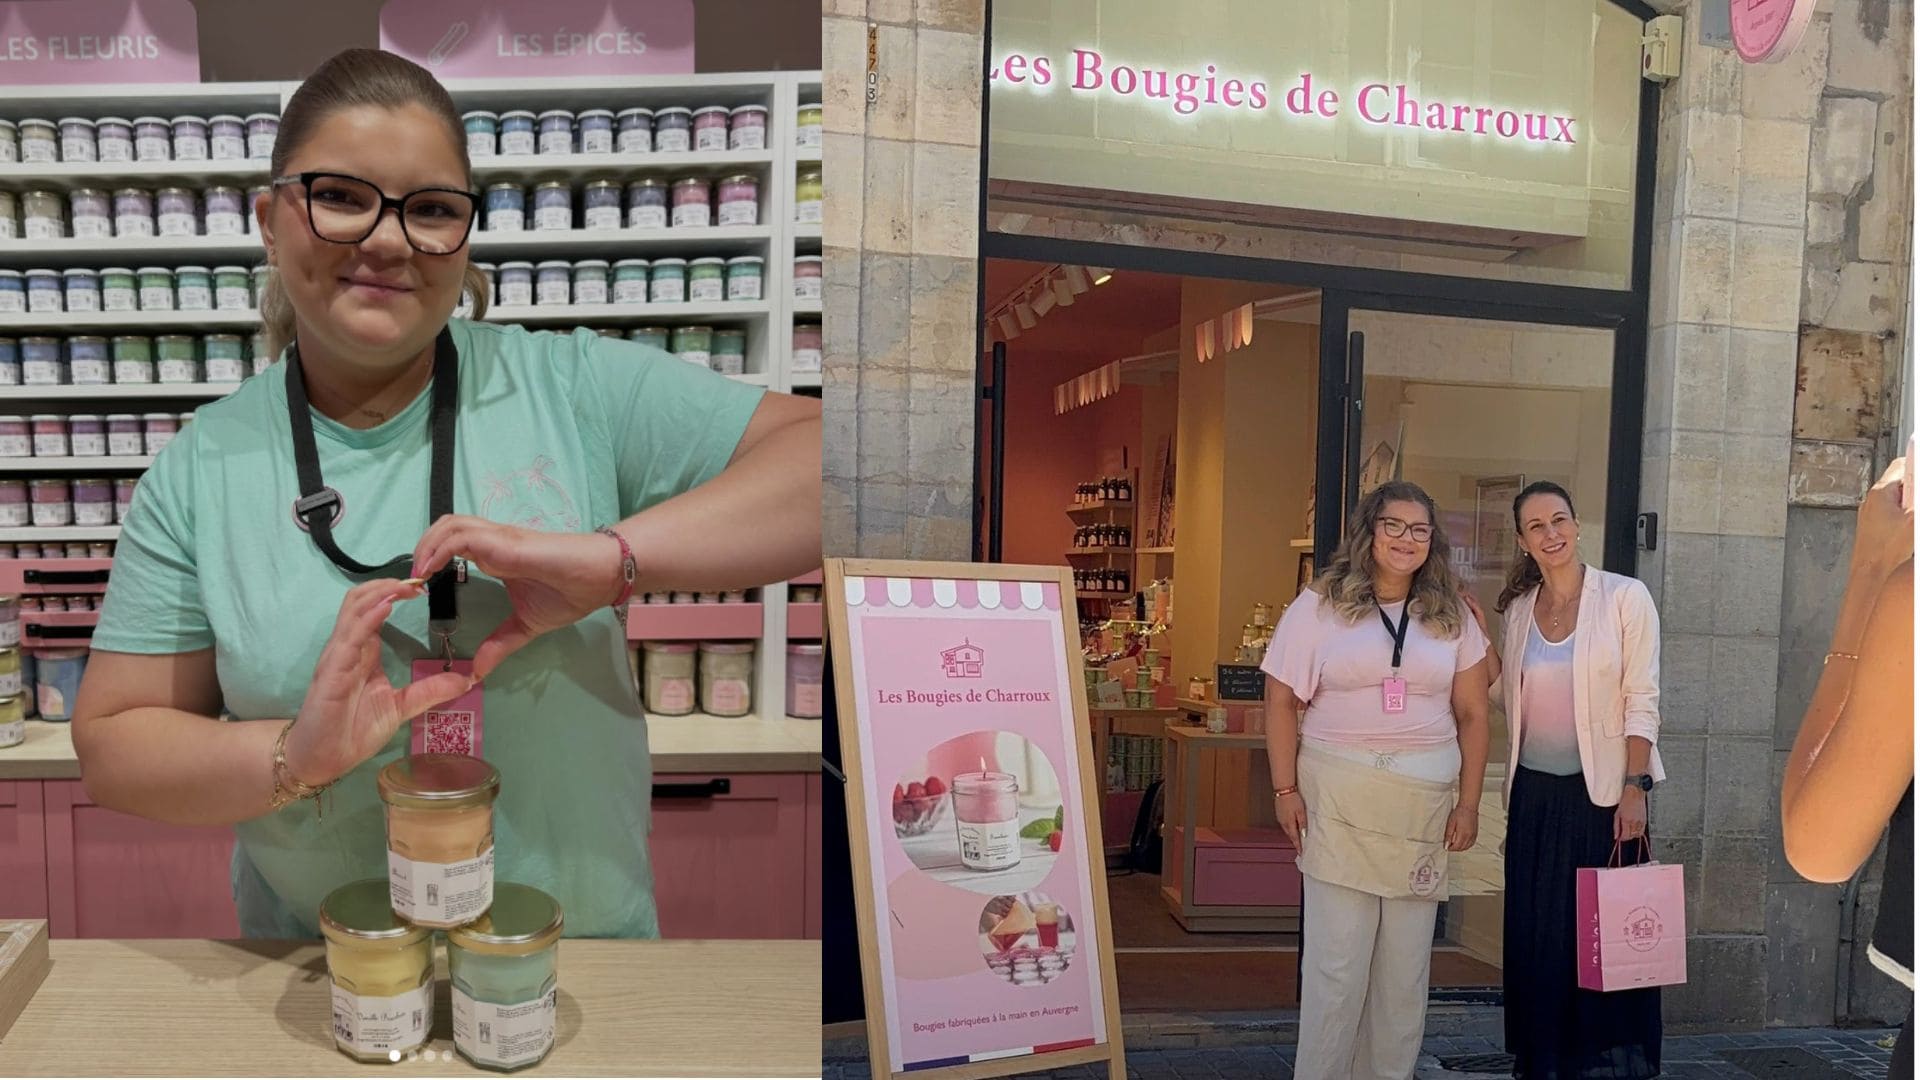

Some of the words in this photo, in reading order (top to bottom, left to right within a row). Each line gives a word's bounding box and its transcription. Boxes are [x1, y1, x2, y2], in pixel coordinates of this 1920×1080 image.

[48, 35, 159, 61] FLEURIS
[497, 33, 543, 57] LES
[553, 27, 647, 57] ÉPICÉS
[1072, 49, 1268, 115] Bougies
[1286, 73, 1339, 118] de
[1356, 84, 1577, 144] Charroux
[878, 689, 902, 703] Les
[906, 689, 962, 707] Bougies
[966, 688, 982, 703] de
[985, 688, 1051, 703] Charroux
[913, 1022, 946, 1033] Bougies
[948, 1015, 990, 1028] fabriquées
[992, 1012, 998, 1022] à
[999, 1012, 1007, 1022] la
[1008, 1010, 1028, 1020] main
[1030, 1009, 1040, 1018] en
[1041, 1004, 1079, 1017] Auvergne
